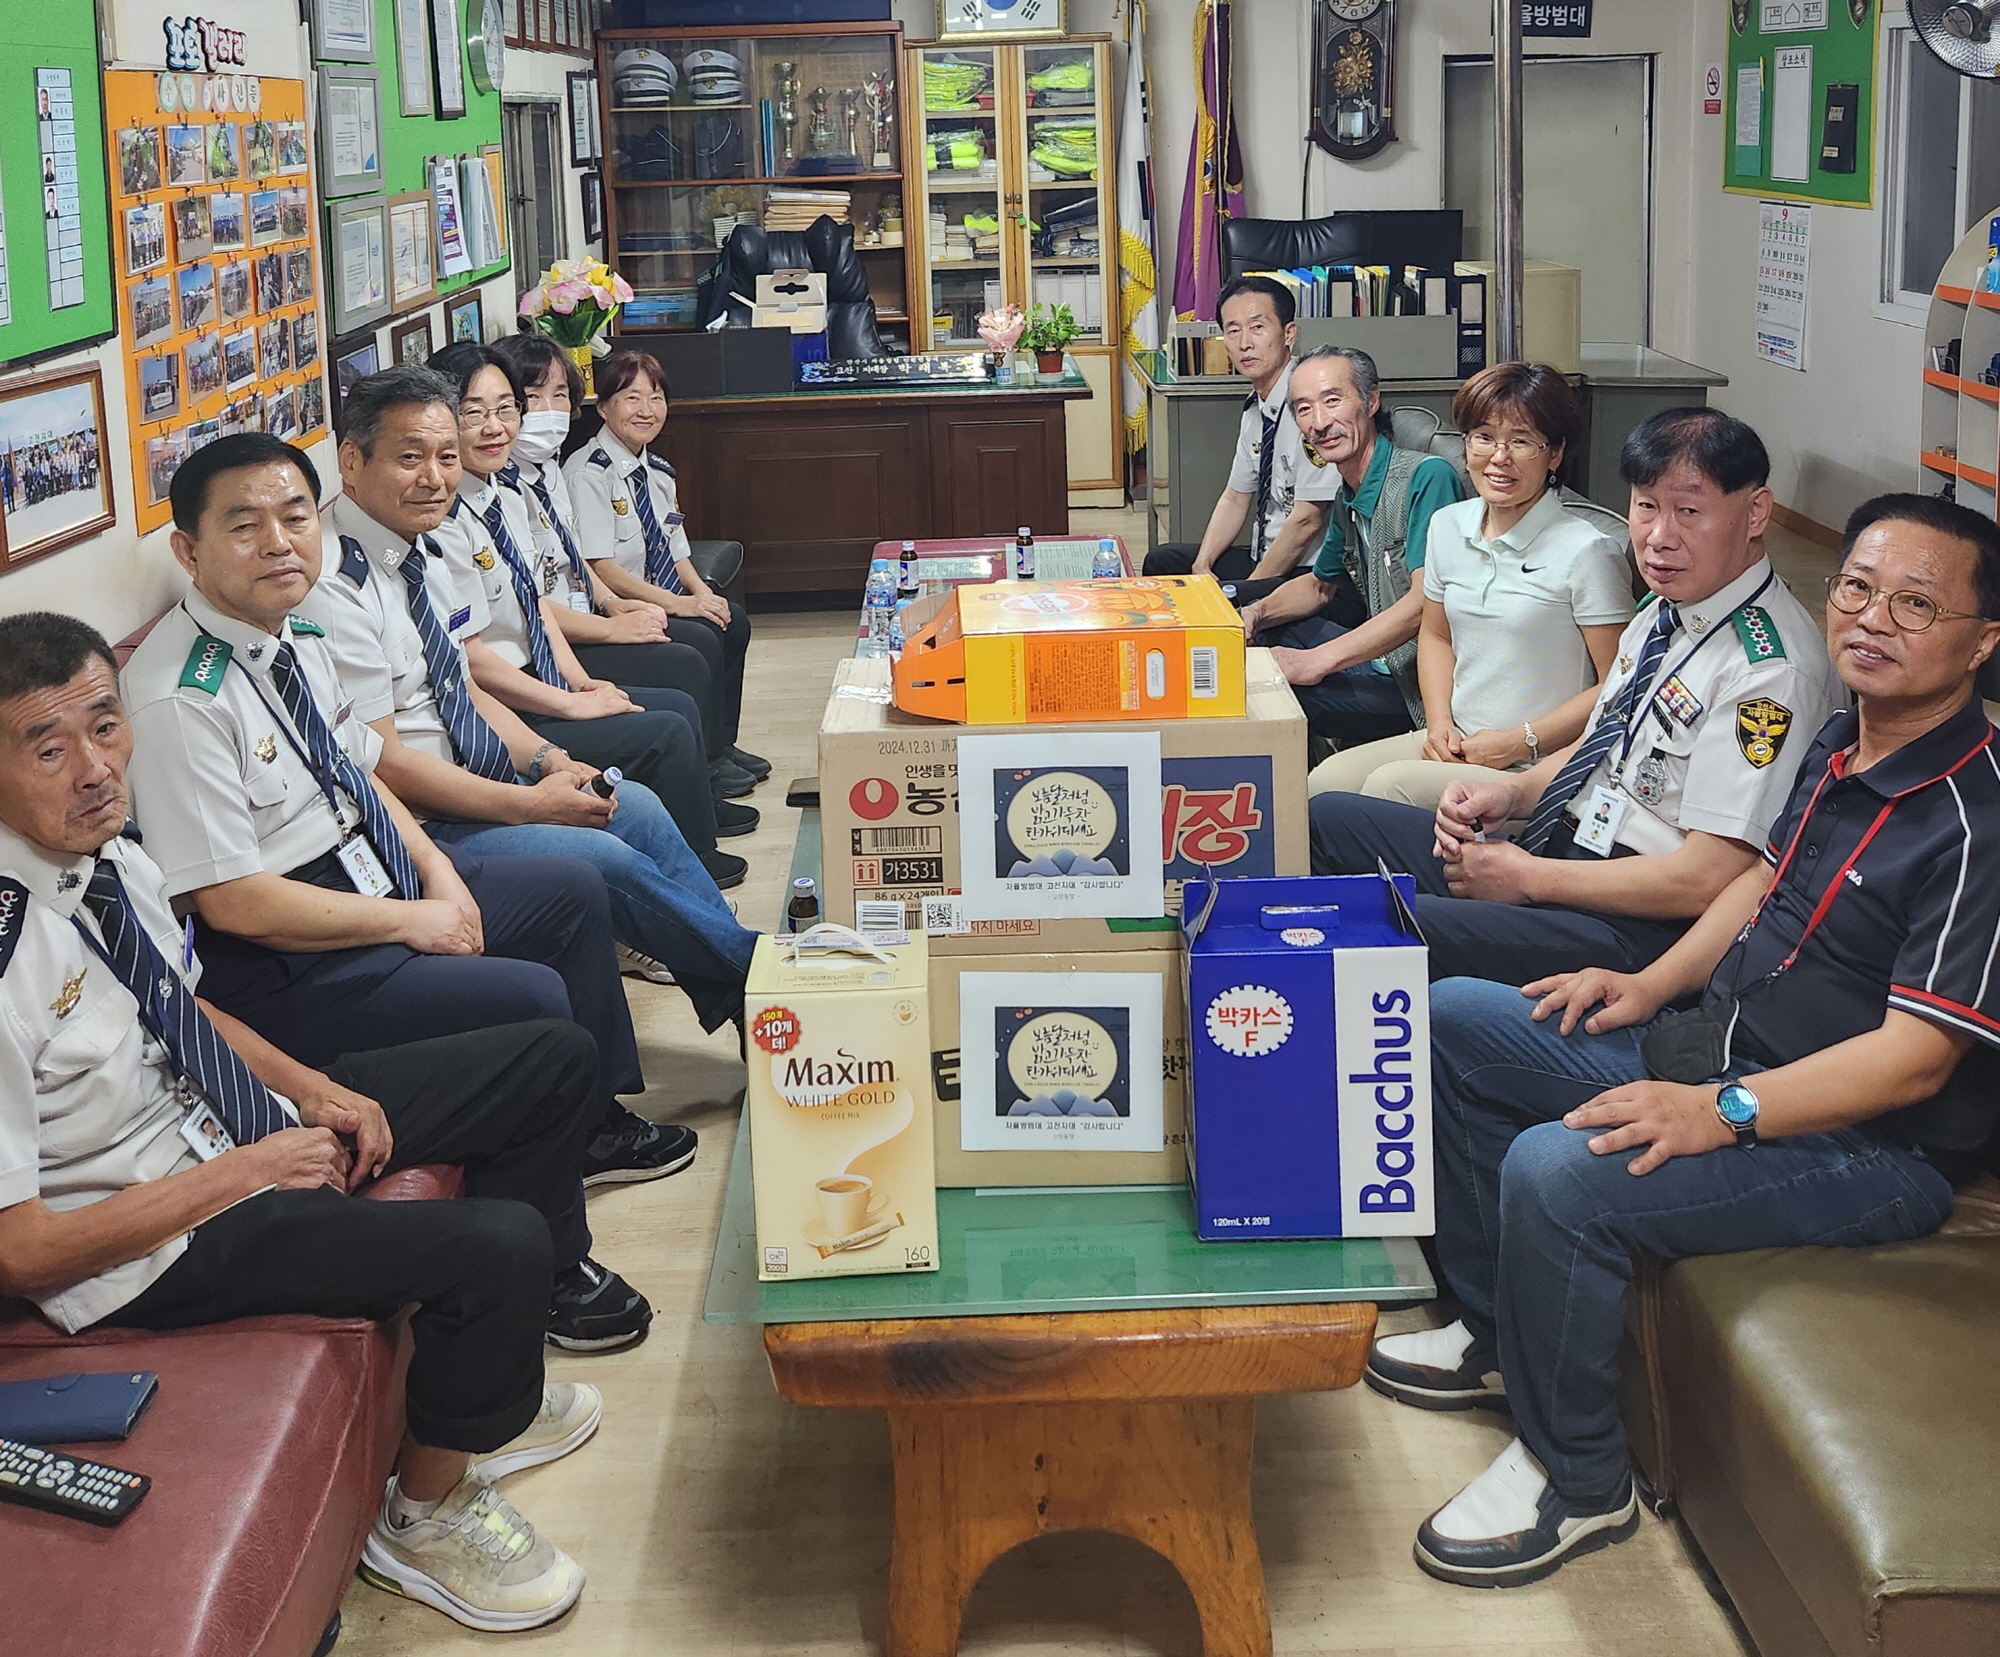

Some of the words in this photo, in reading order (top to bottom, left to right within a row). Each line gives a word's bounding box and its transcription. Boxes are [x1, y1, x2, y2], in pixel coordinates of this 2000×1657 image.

[1350, 9, 1358, 17] 6
[1521, 4, 1586, 27] 율방범대
[1782, 208, 1788, 221] 9
[878, 740, 936, 755] 2024.12.31
[904, 764, 946, 779] 인생을
[1032, 784, 1090, 806] 보름달처럼
[885, 860, 939, 882] 가3531
[1005, 882, 1043, 890] 자율방범대
[1047, 881, 1076, 890] 고잔지대
[996, 919, 1035, 933] 마세요
[1286, 931, 1320, 939] 박카스
[762, 1010, 783, 1022] 150개
[1218, 1006, 1283, 1028] 박카스
[754, 1020, 794, 1038] +10개
[1033, 1024, 1091, 1046] 보름달처럼
[771, 1036, 787, 1050] 더!
[1244, 1030, 1259, 1047] F
[784, 1055, 895, 1087] Maxim
[785, 1093, 844, 1108] WHITE
[847, 1091, 896, 1106] GOLD
[1349, 989, 1416, 1214] Bacchus
[821, 1113, 846, 1121] COFFEE
[847, 1112, 861, 1120] MIX
[1005, 1121, 1043, 1130] 자율방범대
[1212, 1216, 1242, 1227] 120mL
[1252, 1216, 1271, 1227] 20병
[904, 1245, 931, 1262] 160
